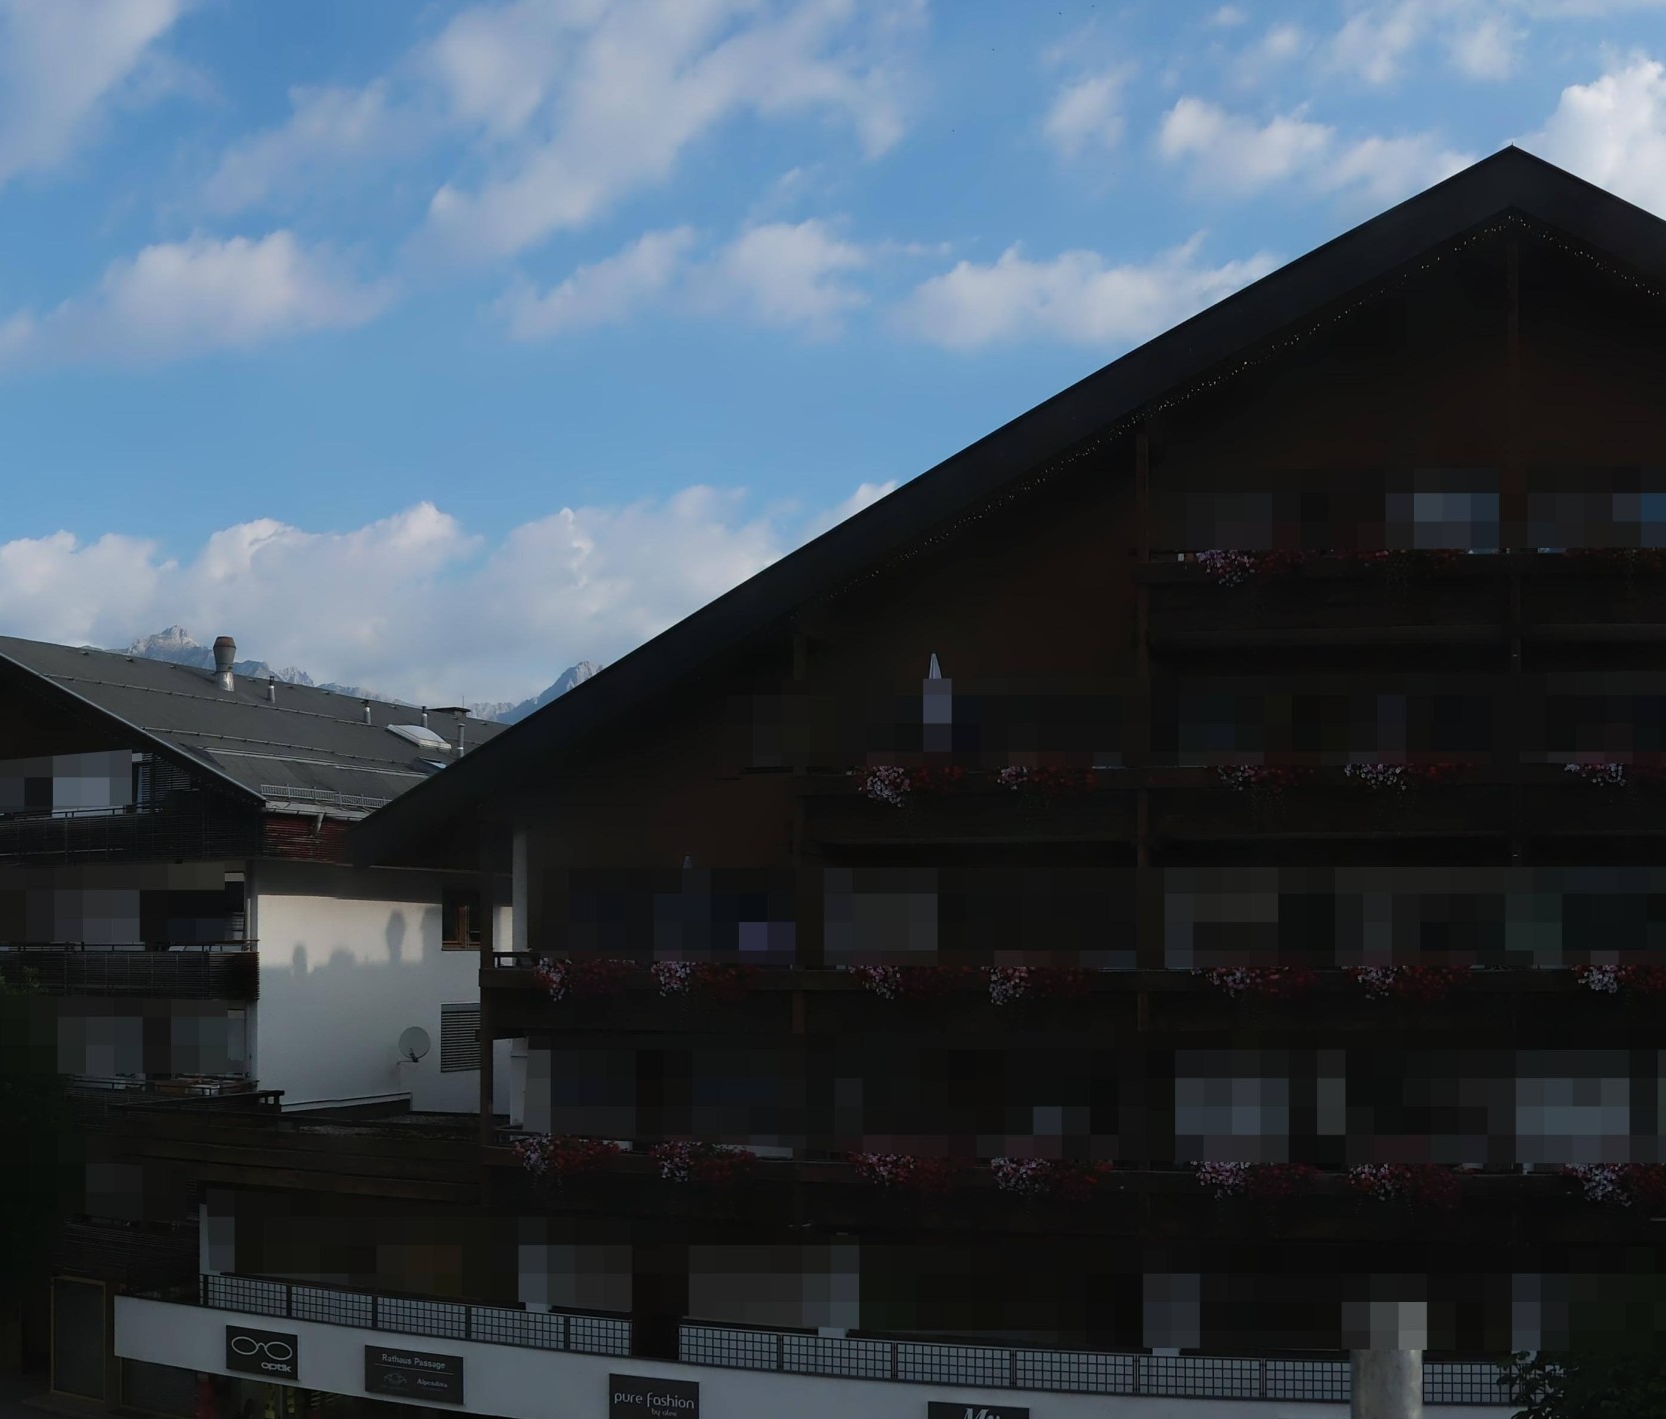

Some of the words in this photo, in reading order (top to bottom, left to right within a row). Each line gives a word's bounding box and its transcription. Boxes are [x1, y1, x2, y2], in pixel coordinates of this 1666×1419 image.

[261, 1361, 292, 1373] optik
[381, 1353, 412, 1365] Rathaus
[414, 1357, 446, 1370] Passage
[614, 1392, 643, 1404] pure
[647, 1392, 695, 1409] fashion
